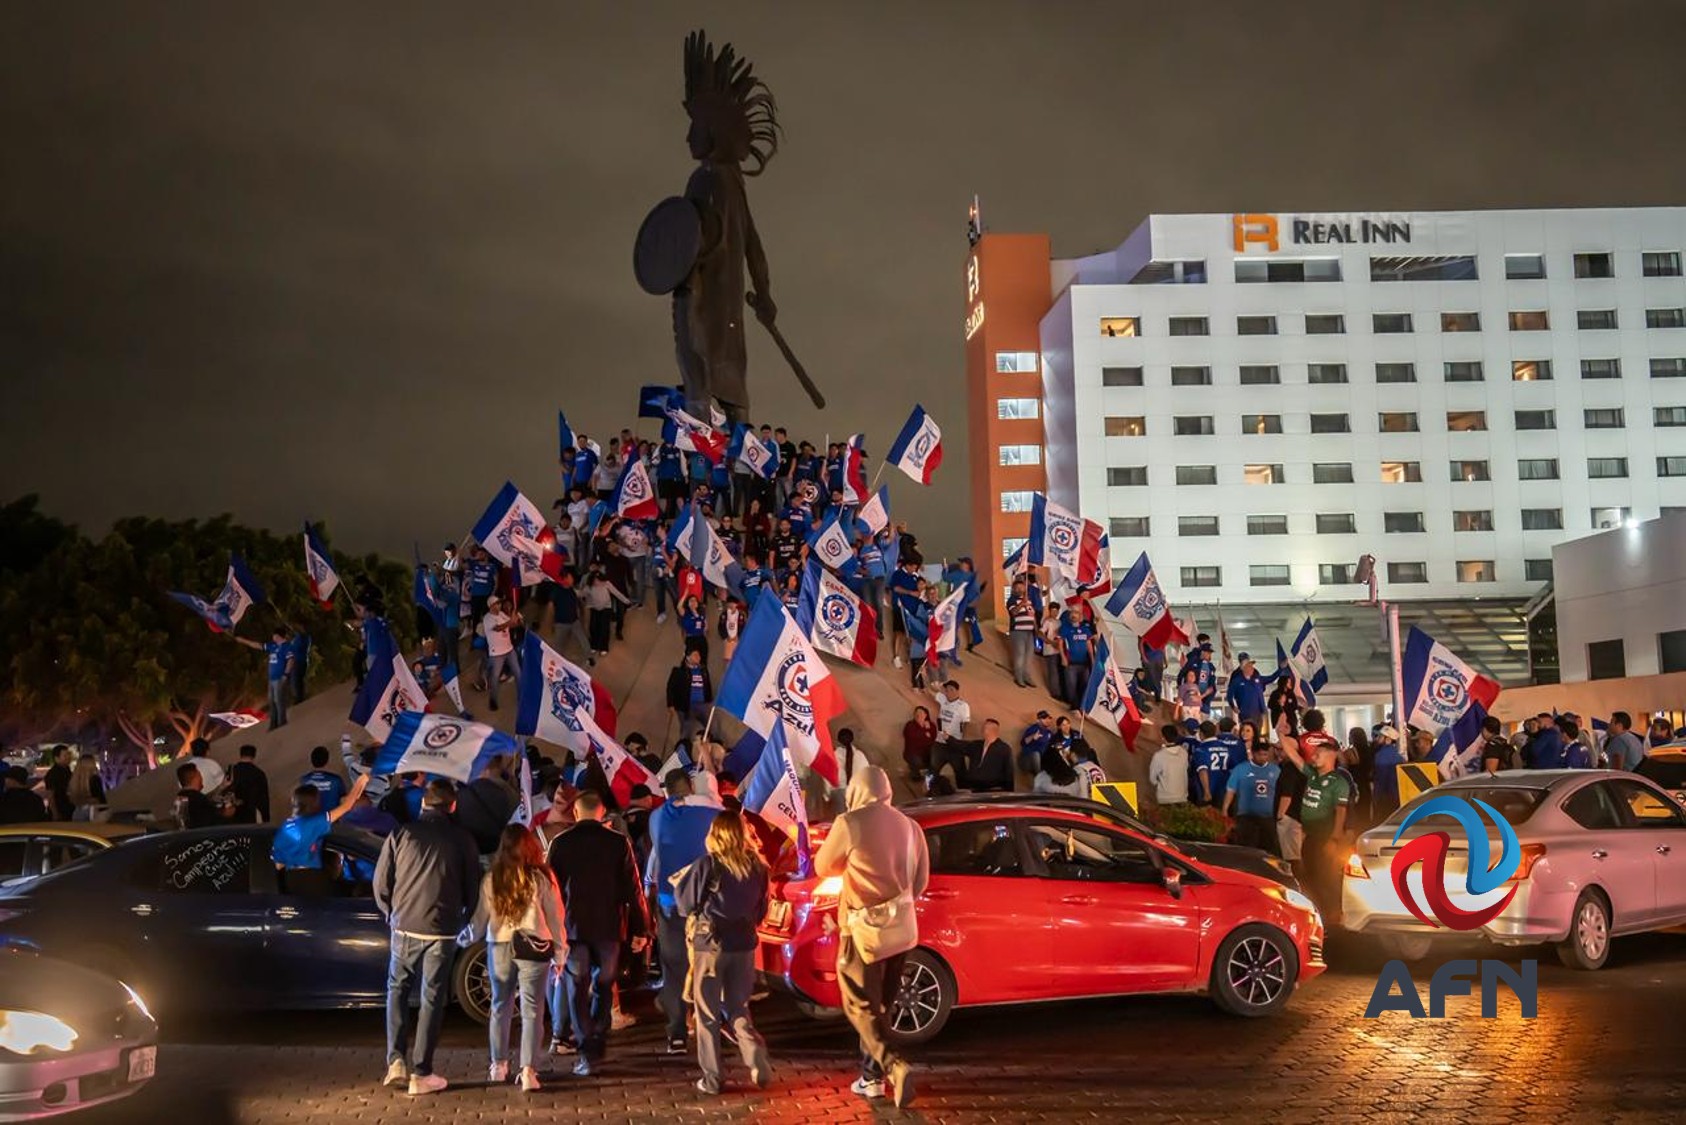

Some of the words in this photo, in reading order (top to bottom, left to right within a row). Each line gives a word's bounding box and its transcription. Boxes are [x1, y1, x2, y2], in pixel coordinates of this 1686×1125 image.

[1293, 219, 1357, 244] REAL
[1362, 219, 1411, 243] INN
[764, 699, 815, 736] Azul
[1210, 753, 1229, 770] 27
